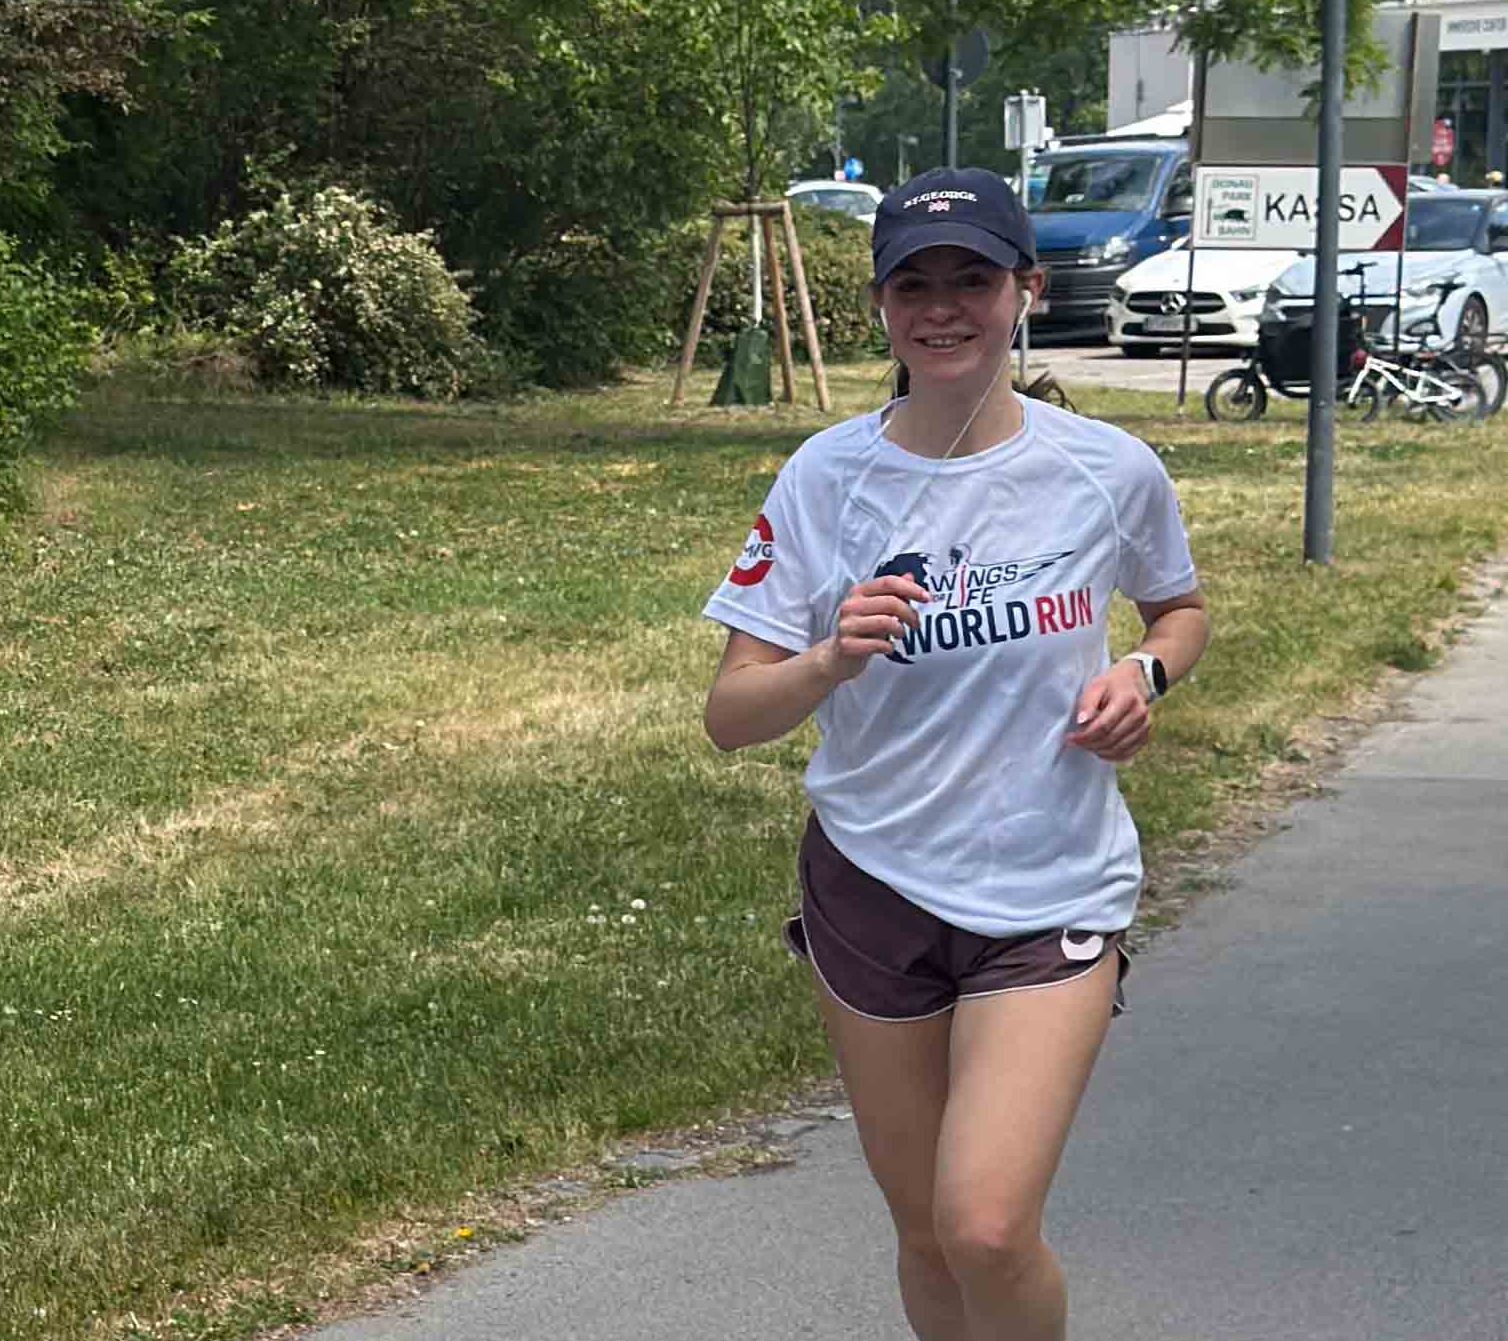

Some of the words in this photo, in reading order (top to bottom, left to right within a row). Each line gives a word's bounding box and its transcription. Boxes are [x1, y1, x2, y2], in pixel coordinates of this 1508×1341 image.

[1264, 193, 1381, 223] KASA
[930, 563, 1019, 592] WINGS
[945, 586, 997, 610] LIFE
[902, 600, 1031, 656] WORLD
[1035, 586, 1093, 636] RUN
